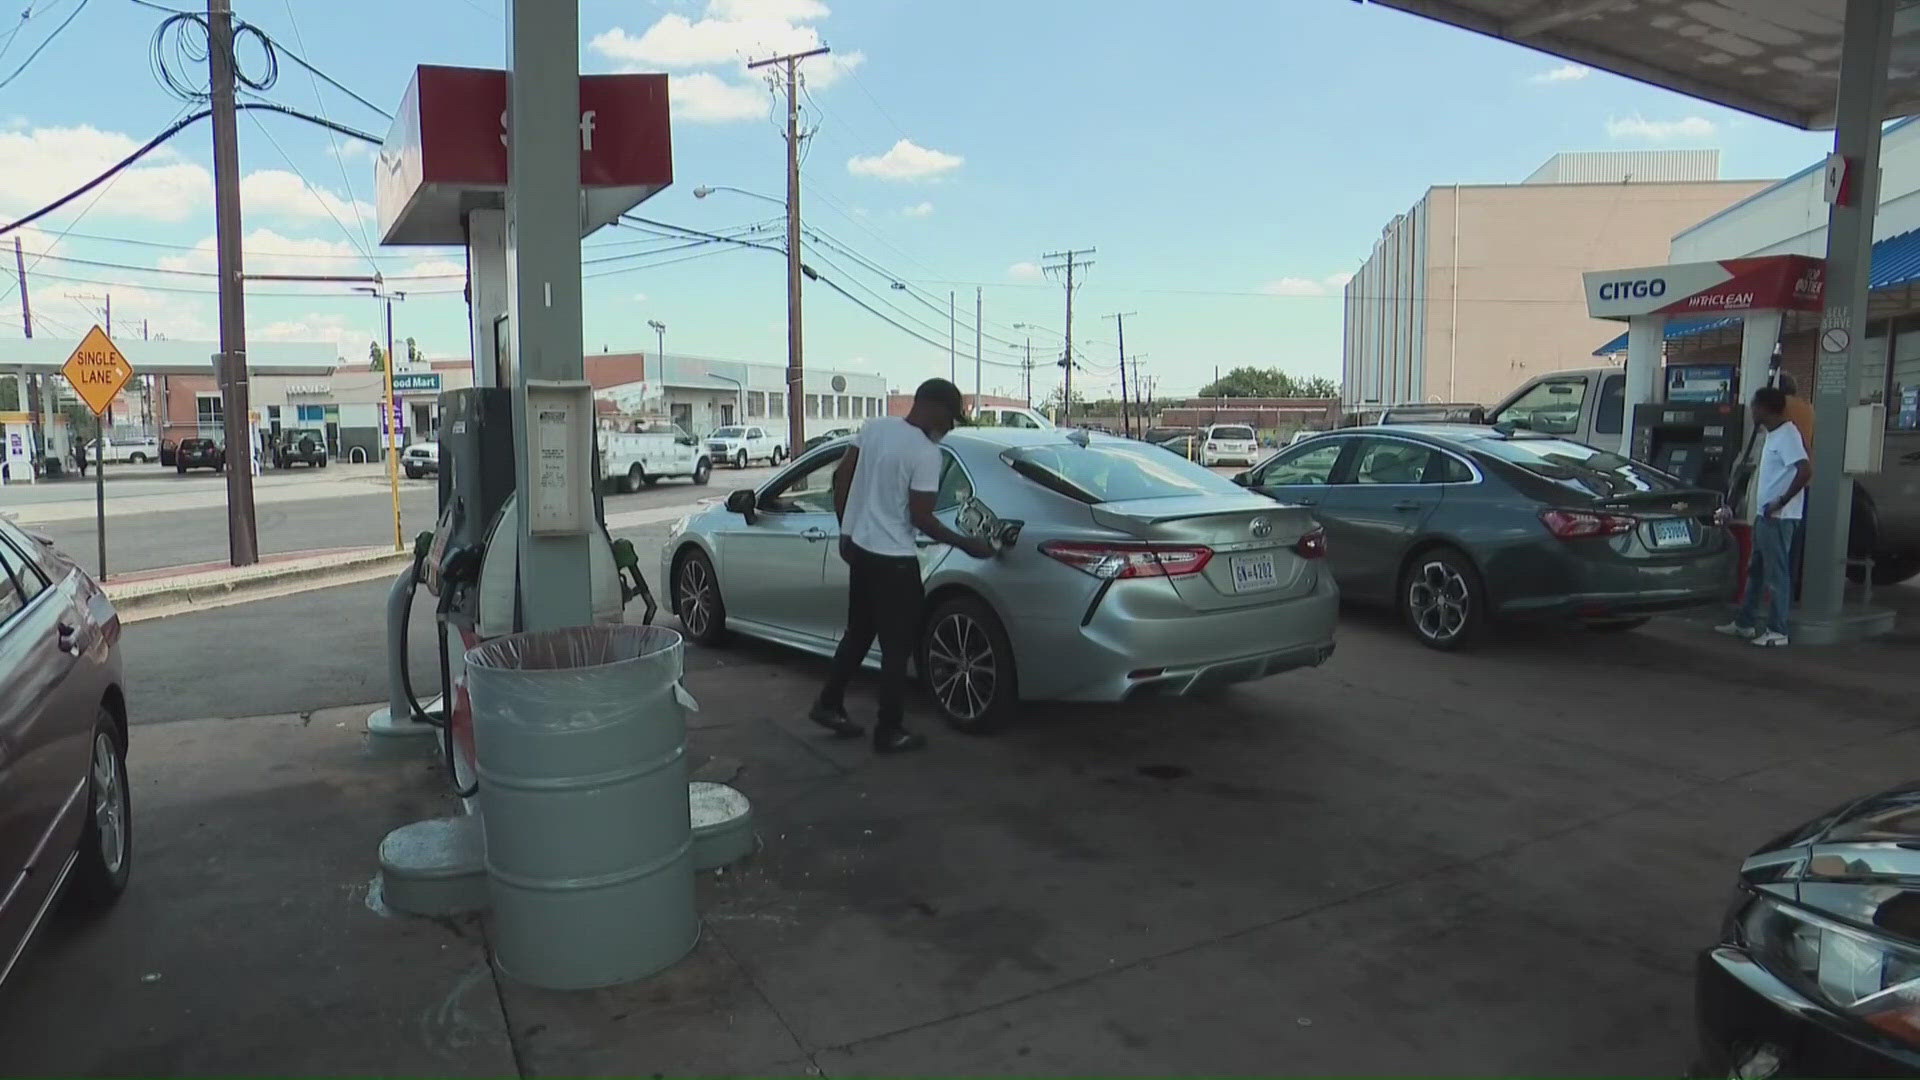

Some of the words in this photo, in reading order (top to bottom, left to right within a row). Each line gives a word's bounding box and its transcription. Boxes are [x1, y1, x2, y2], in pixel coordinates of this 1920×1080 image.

[1830, 167, 1836, 188] 4
[1599, 278, 1666, 300] CITGO
[1826, 305, 1848, 318] SELF
[1822, 318, 1851, 329] SERVE
[77, 352, 117, 366] SINGLE
[81, 370, 112, 384] LANE
[393, 377, 411, 388] ood
[412, 377, 435, 388] Mart
